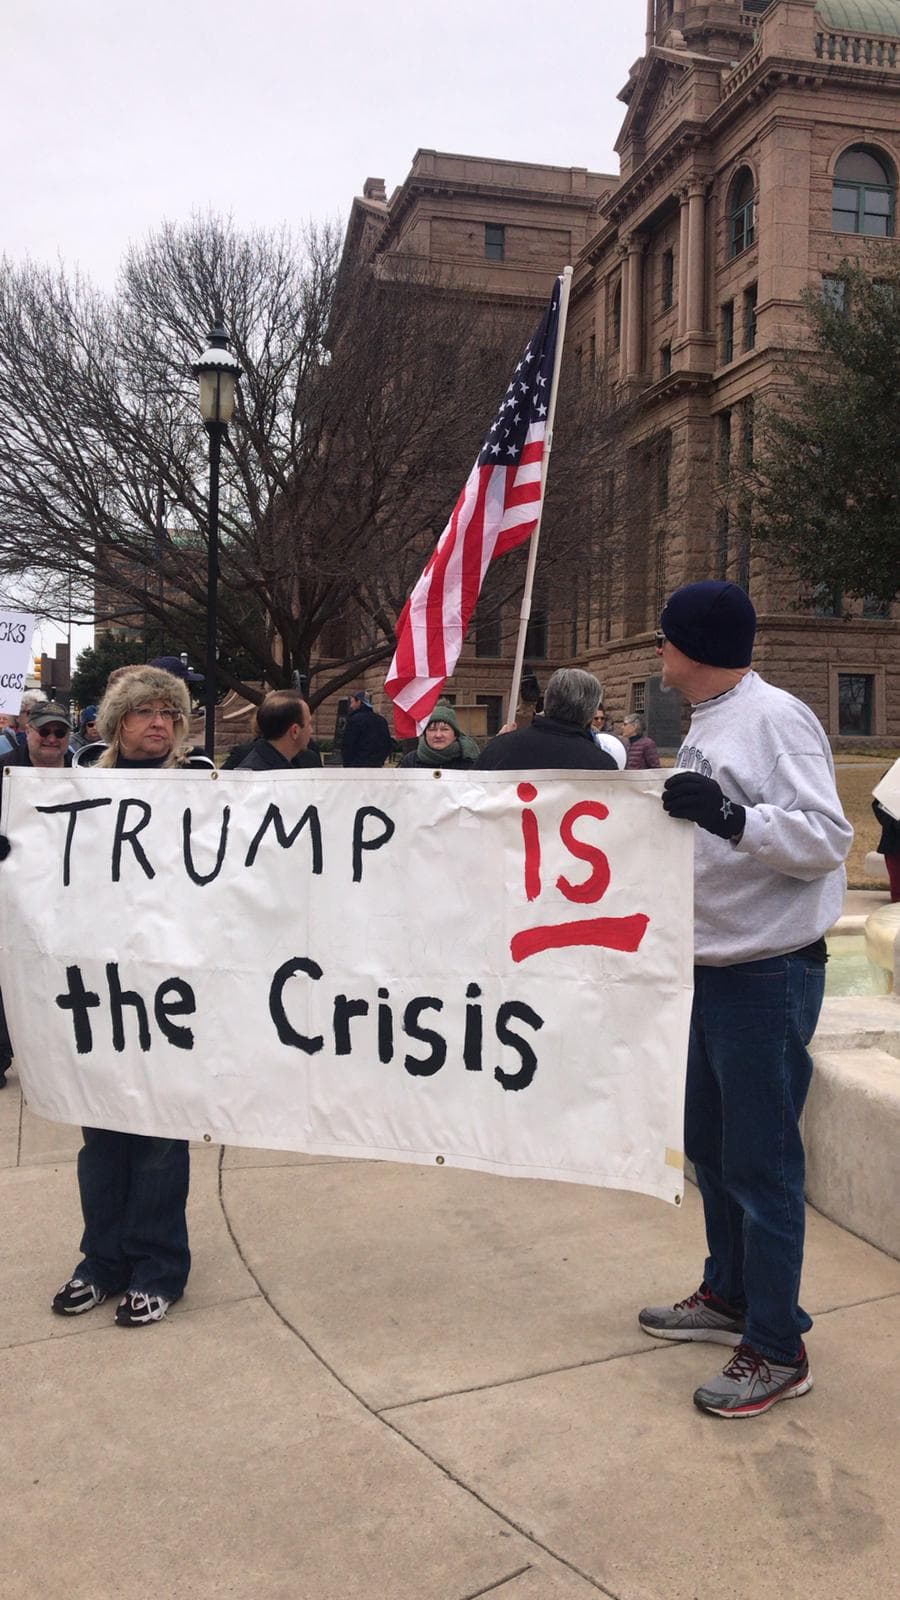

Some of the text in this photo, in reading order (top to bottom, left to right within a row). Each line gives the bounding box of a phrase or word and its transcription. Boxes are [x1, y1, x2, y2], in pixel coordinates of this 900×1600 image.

[35, 782, 610, 904] TRUMP is
[56, 957, 544, 1091] the Crisis
